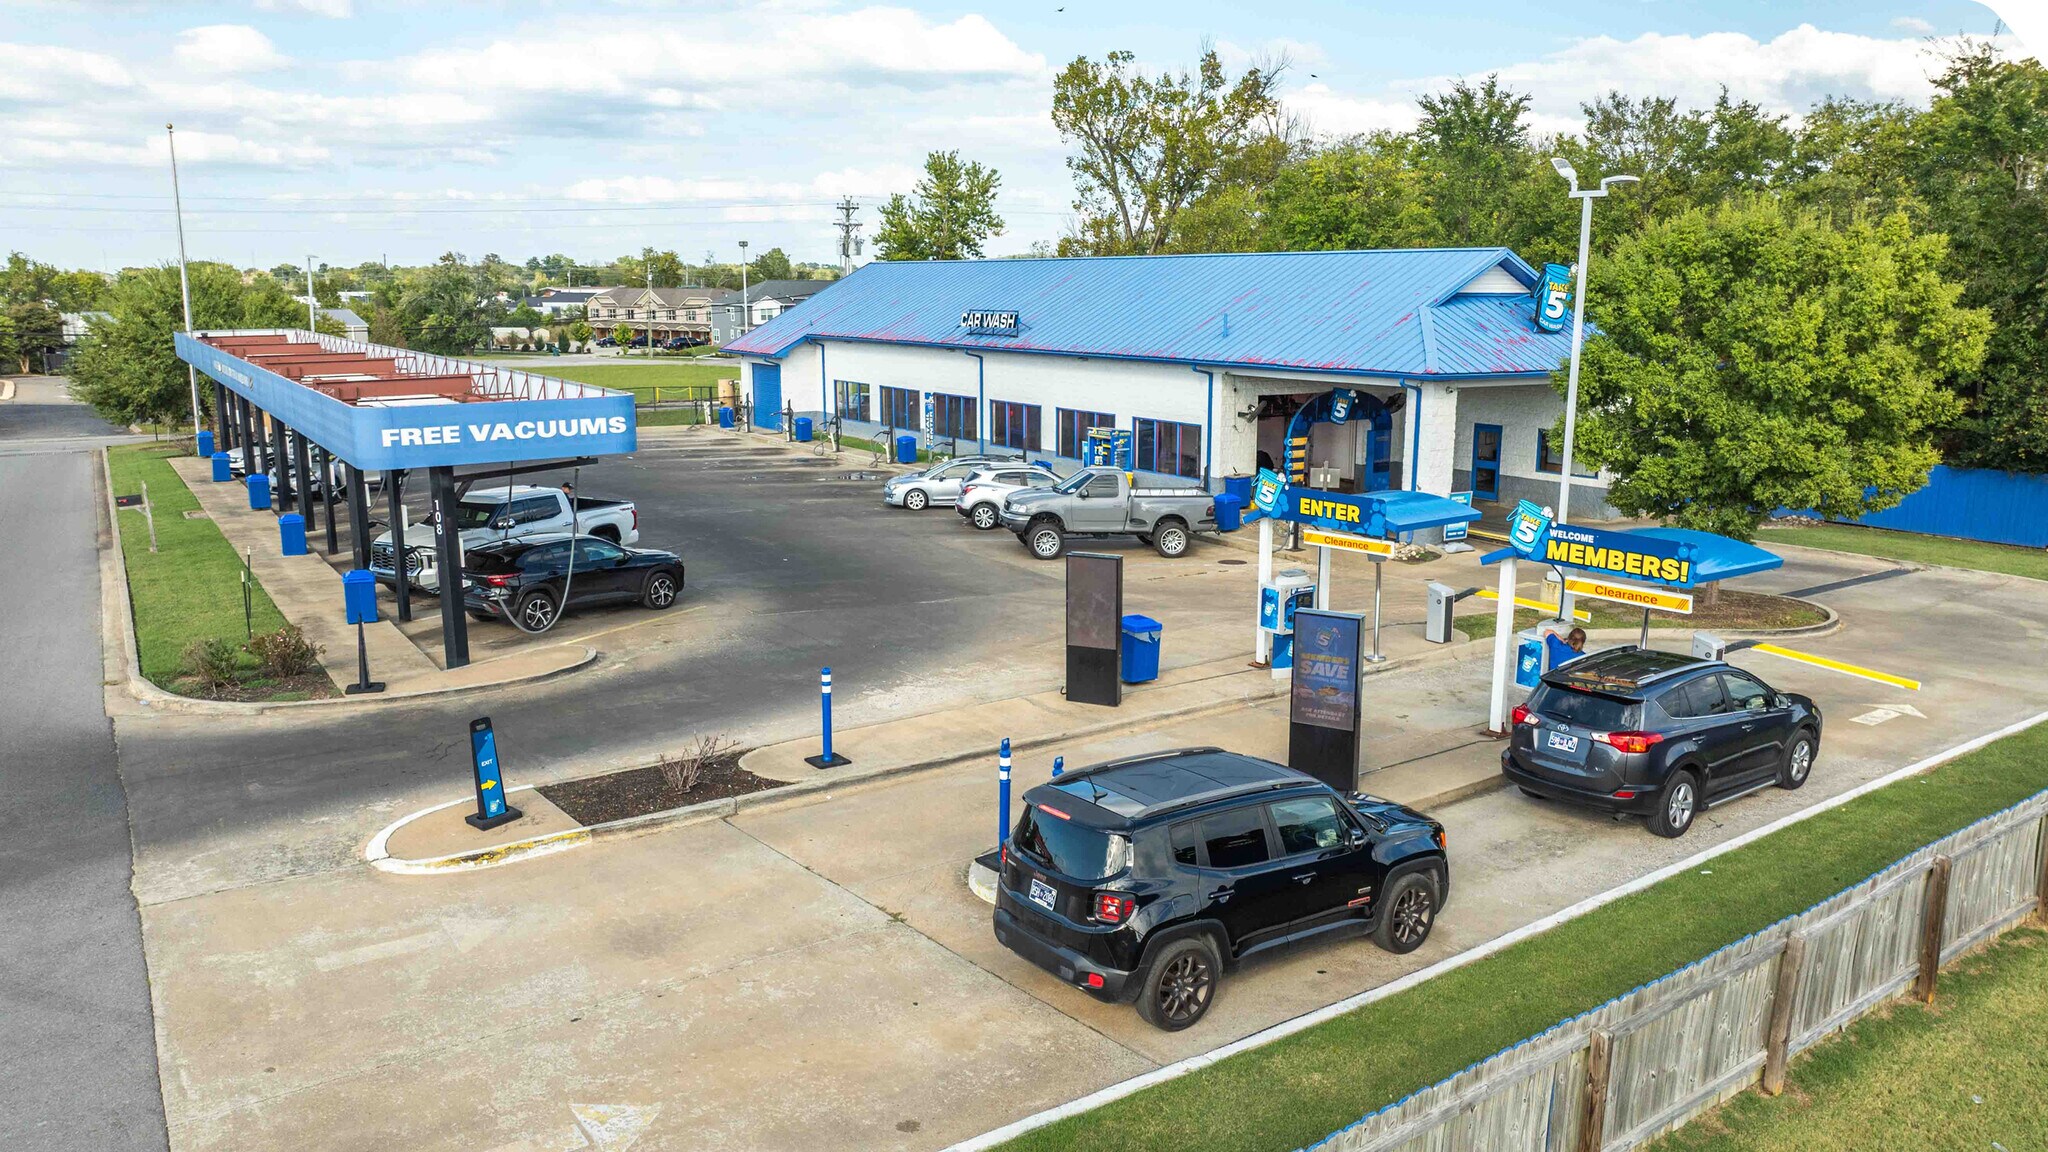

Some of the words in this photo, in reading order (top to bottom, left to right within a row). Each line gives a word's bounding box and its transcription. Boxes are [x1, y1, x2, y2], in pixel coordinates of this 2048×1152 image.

[1545, 291, 1567, 318] 5
[960, 312, 981, 327] CAR
[983, 313, 1015, 328] WASH
[1333, 402, 1349, 418] 5
[381, 425, 461, 447] FREE
[468, 416, 627, 442] VACUUMS
[1258, 485, 1277, 505] 5
[434, 499, 443, 535] 108
[1300, 497, 1361, 523] ENTER
[1521, 513, 1542, 527] TAKE
[1515, 520, 1539, 543] 5
[1549, 529, 1595, 544] WELCOME
[1324, 536, 1369, 550] Clearance
[1546, 539, 1690, 582] MEMBERS!
[1594, 585, 1658, 604] Clearance
[1300, 660, 1350, 679] SAVE
[481, 758, 493, 767] EXIT
